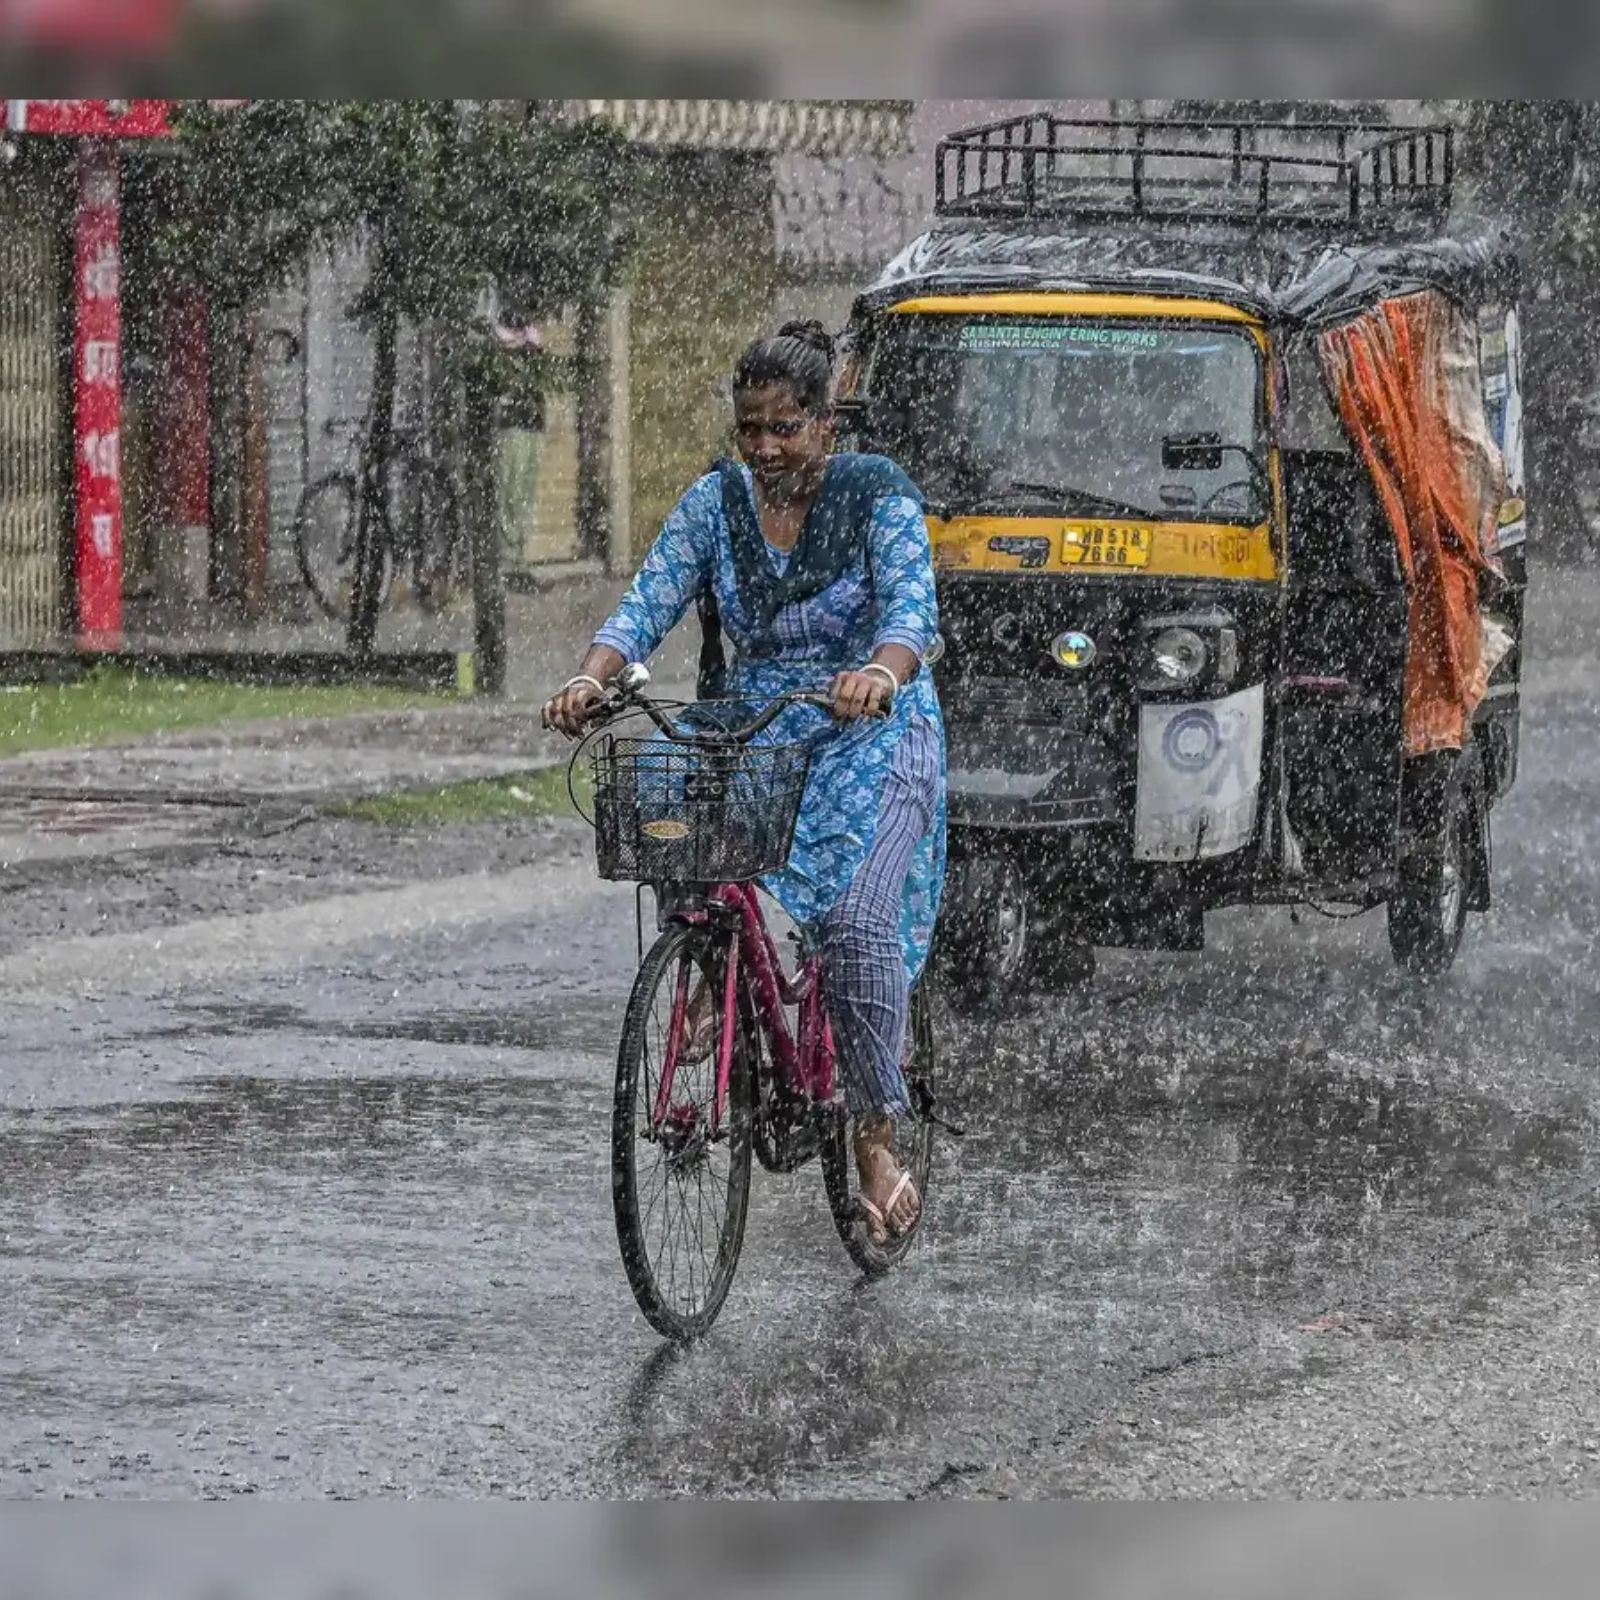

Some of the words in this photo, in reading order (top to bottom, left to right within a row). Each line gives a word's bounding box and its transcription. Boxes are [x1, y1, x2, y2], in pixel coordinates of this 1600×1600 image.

[960, 325, 1021, 339] SAMANTA
[1111, 331, 1158, 347] WORKS
[1079, 544, 1129, 562] 7666
